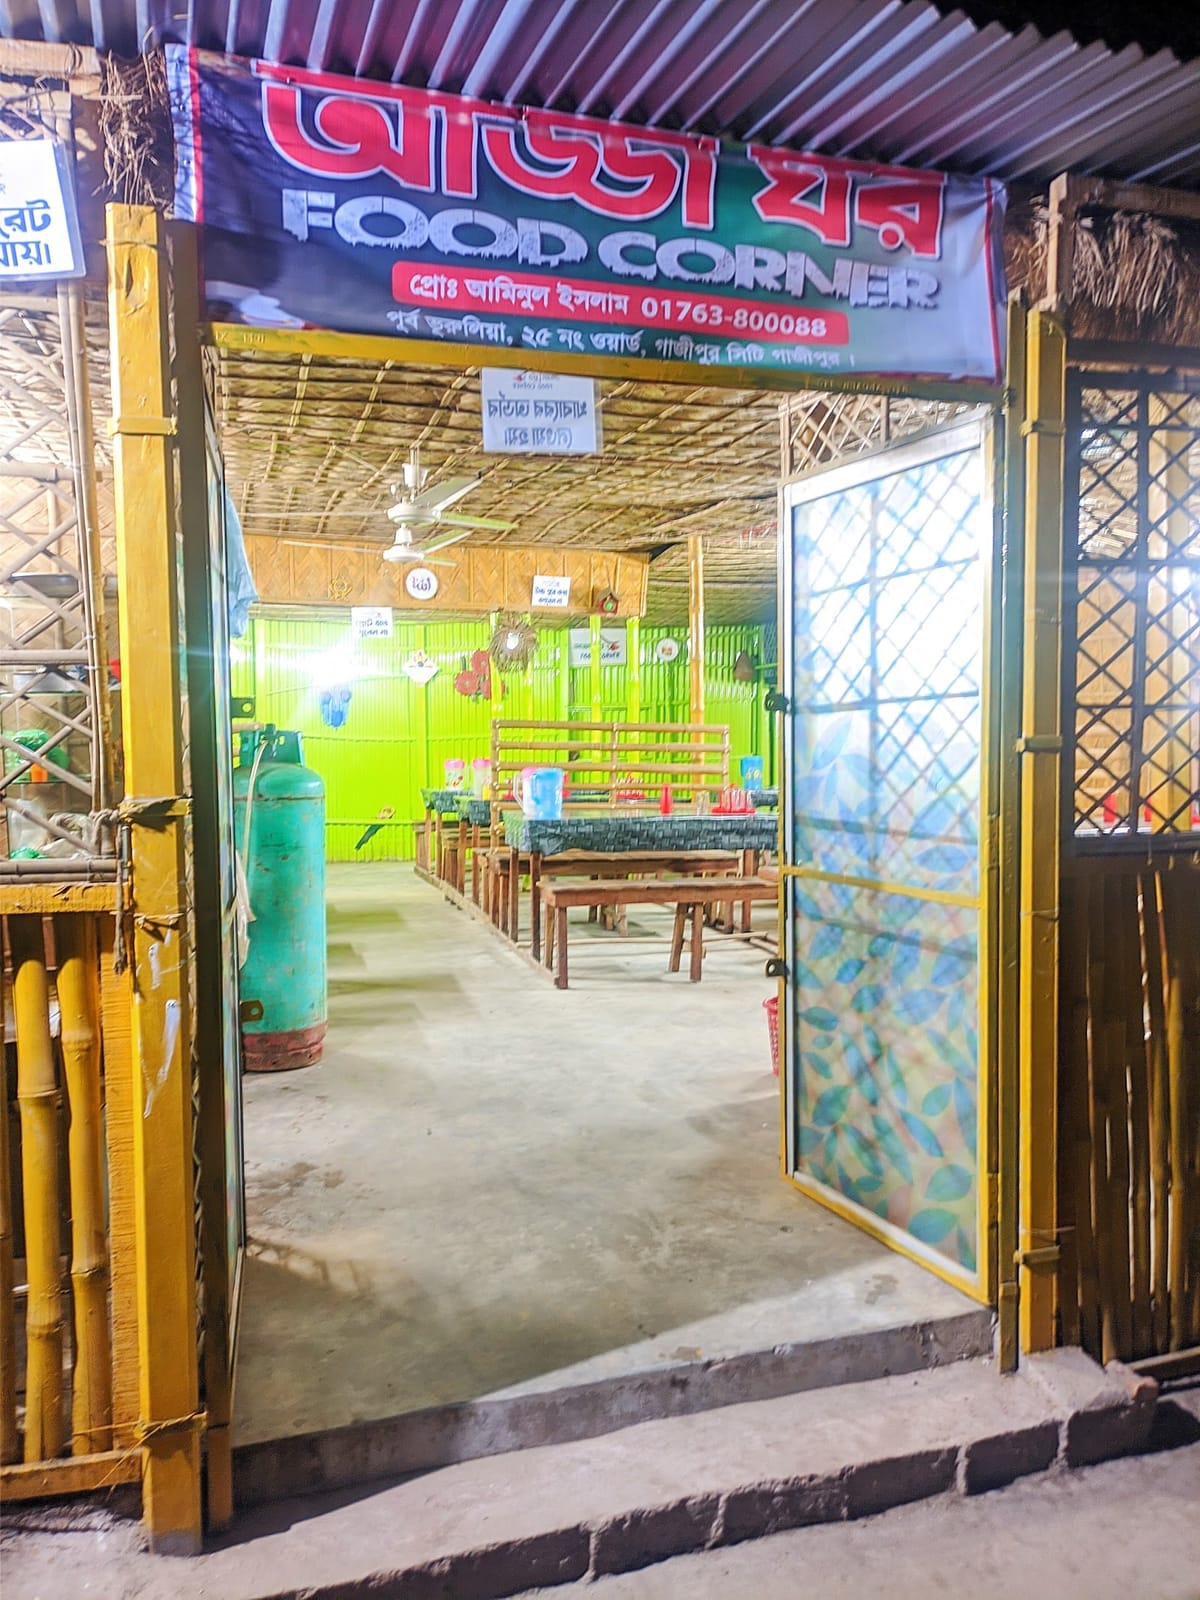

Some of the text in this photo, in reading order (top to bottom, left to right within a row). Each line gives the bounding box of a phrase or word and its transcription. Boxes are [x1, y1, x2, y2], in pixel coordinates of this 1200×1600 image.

[251, 58, 719, 230] আড্ডা
[282, 188, 940, 310] FOOD CORNER
[386, 308, 421, 333] পূর্ব
[522, 326, 552, 348] ২৫
[557, 328, 585, 351] নং
[655, 335, 721, 364] গাজীপুর
[726, 342, 764, 364] সিটি
[772, 346, 840, 368] গাজীপুর
[463, 275, 551, 311] আমিনুল
[556, 281, 629, 315] ইসলাম
[641, 297, 827, 337] 01763-800088
